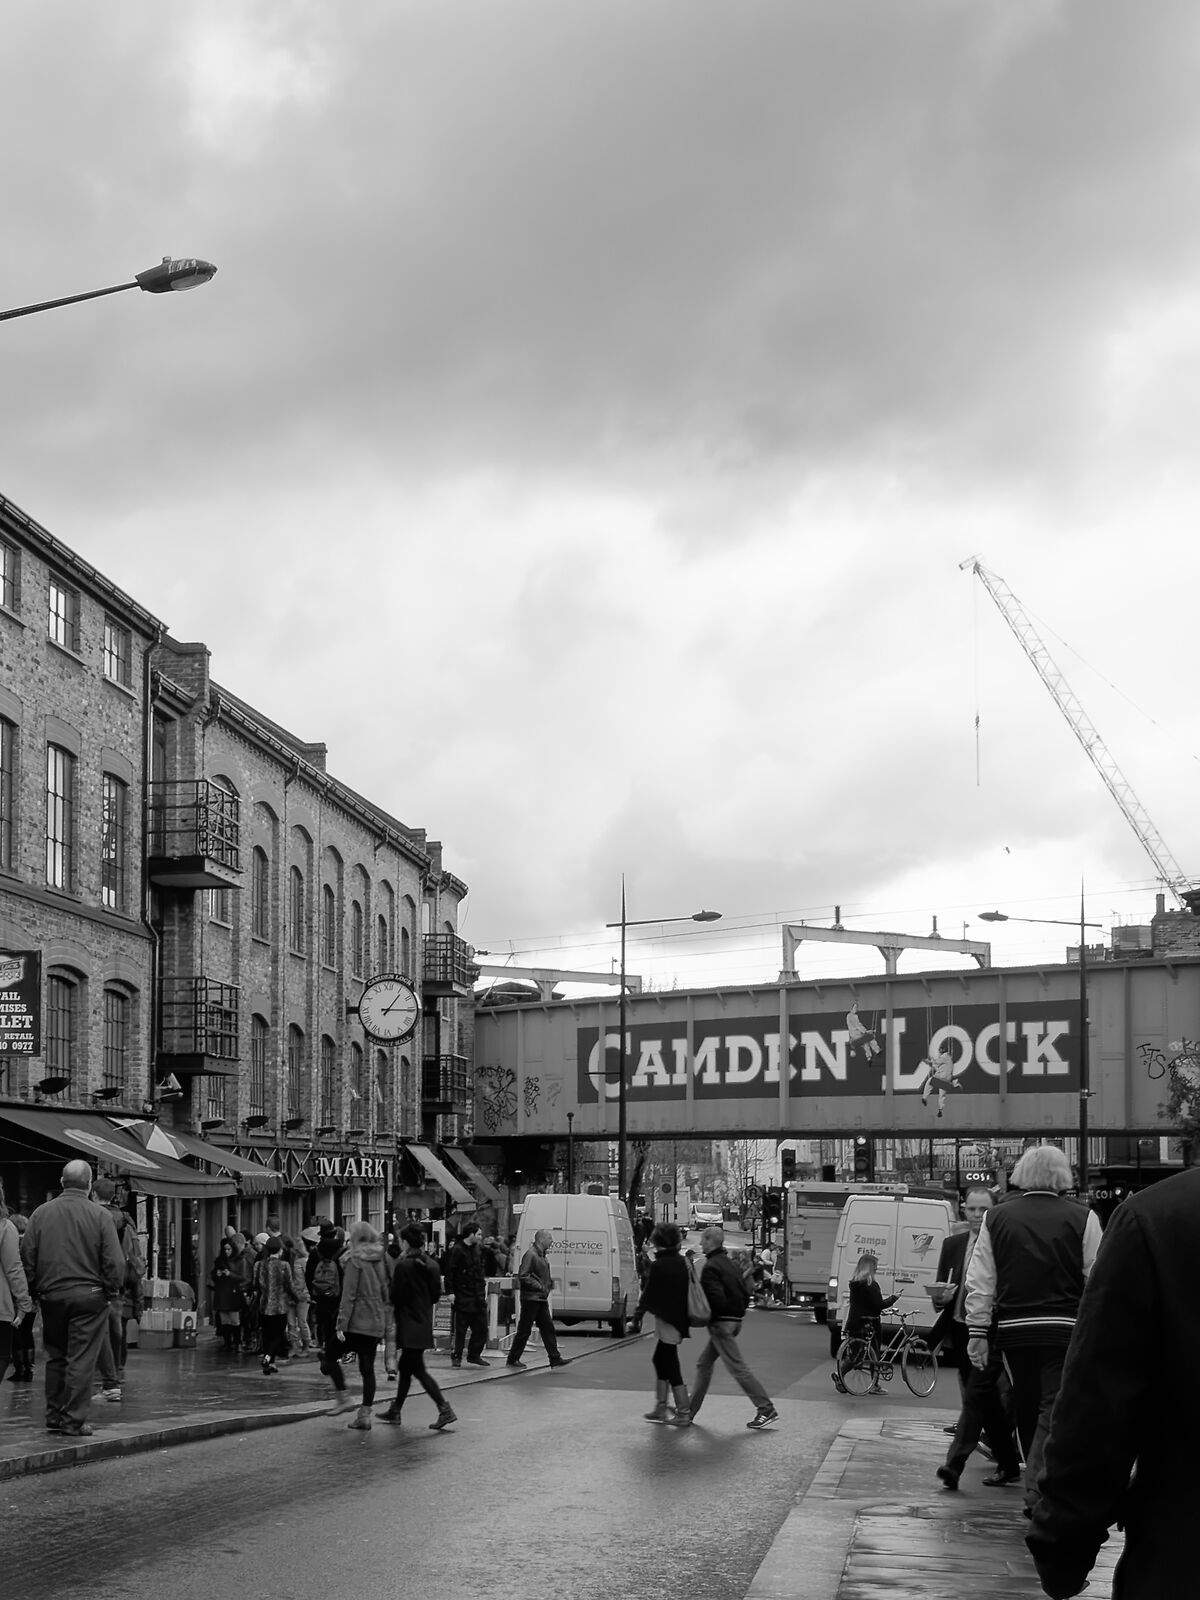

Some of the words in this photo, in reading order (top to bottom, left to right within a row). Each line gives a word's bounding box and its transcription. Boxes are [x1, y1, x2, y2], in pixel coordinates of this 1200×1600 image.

[0, 1015, 34, 1028] LET
[4, 1032, 35, 1040] RETAIL
[11, 1041, 34, 1050] 0977
[588, 1028, 850, 1099] CAMDEN
[880, 1016, 1072, 1091] LOCK
[854, 1234, 887, 1247] Zampa
